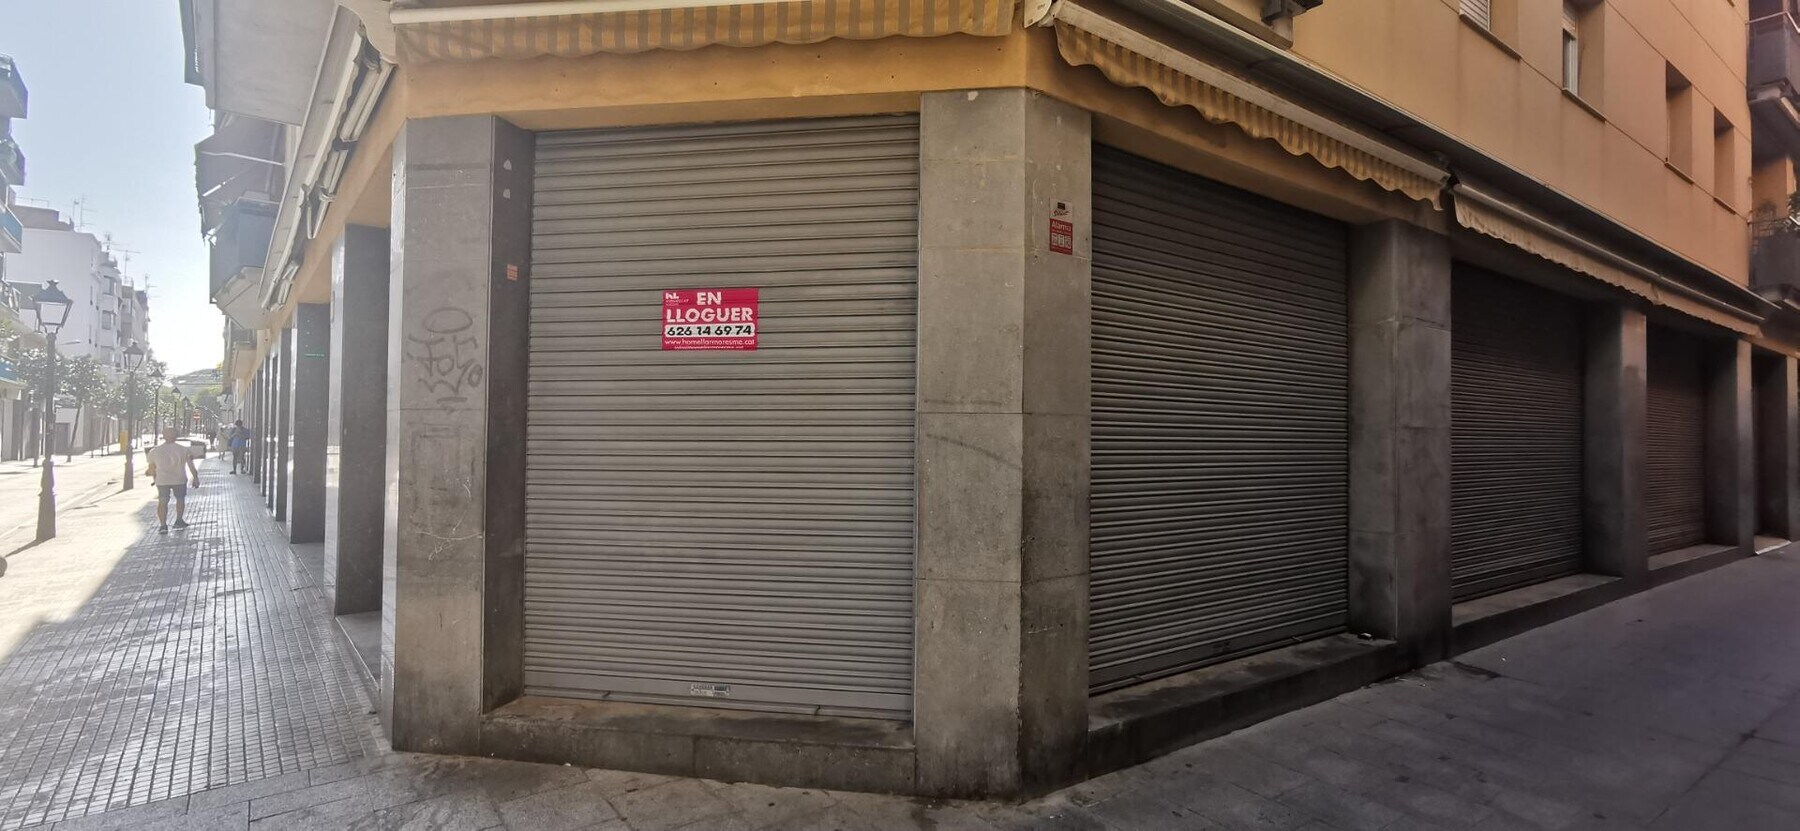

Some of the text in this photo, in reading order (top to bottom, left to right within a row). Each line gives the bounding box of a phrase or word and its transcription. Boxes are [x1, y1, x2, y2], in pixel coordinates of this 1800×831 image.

[697, 292, 722, 305] EN
[666, 307, 753, 322] LLOGUER
[667, 325, 752, 336] 626 14 69 74
